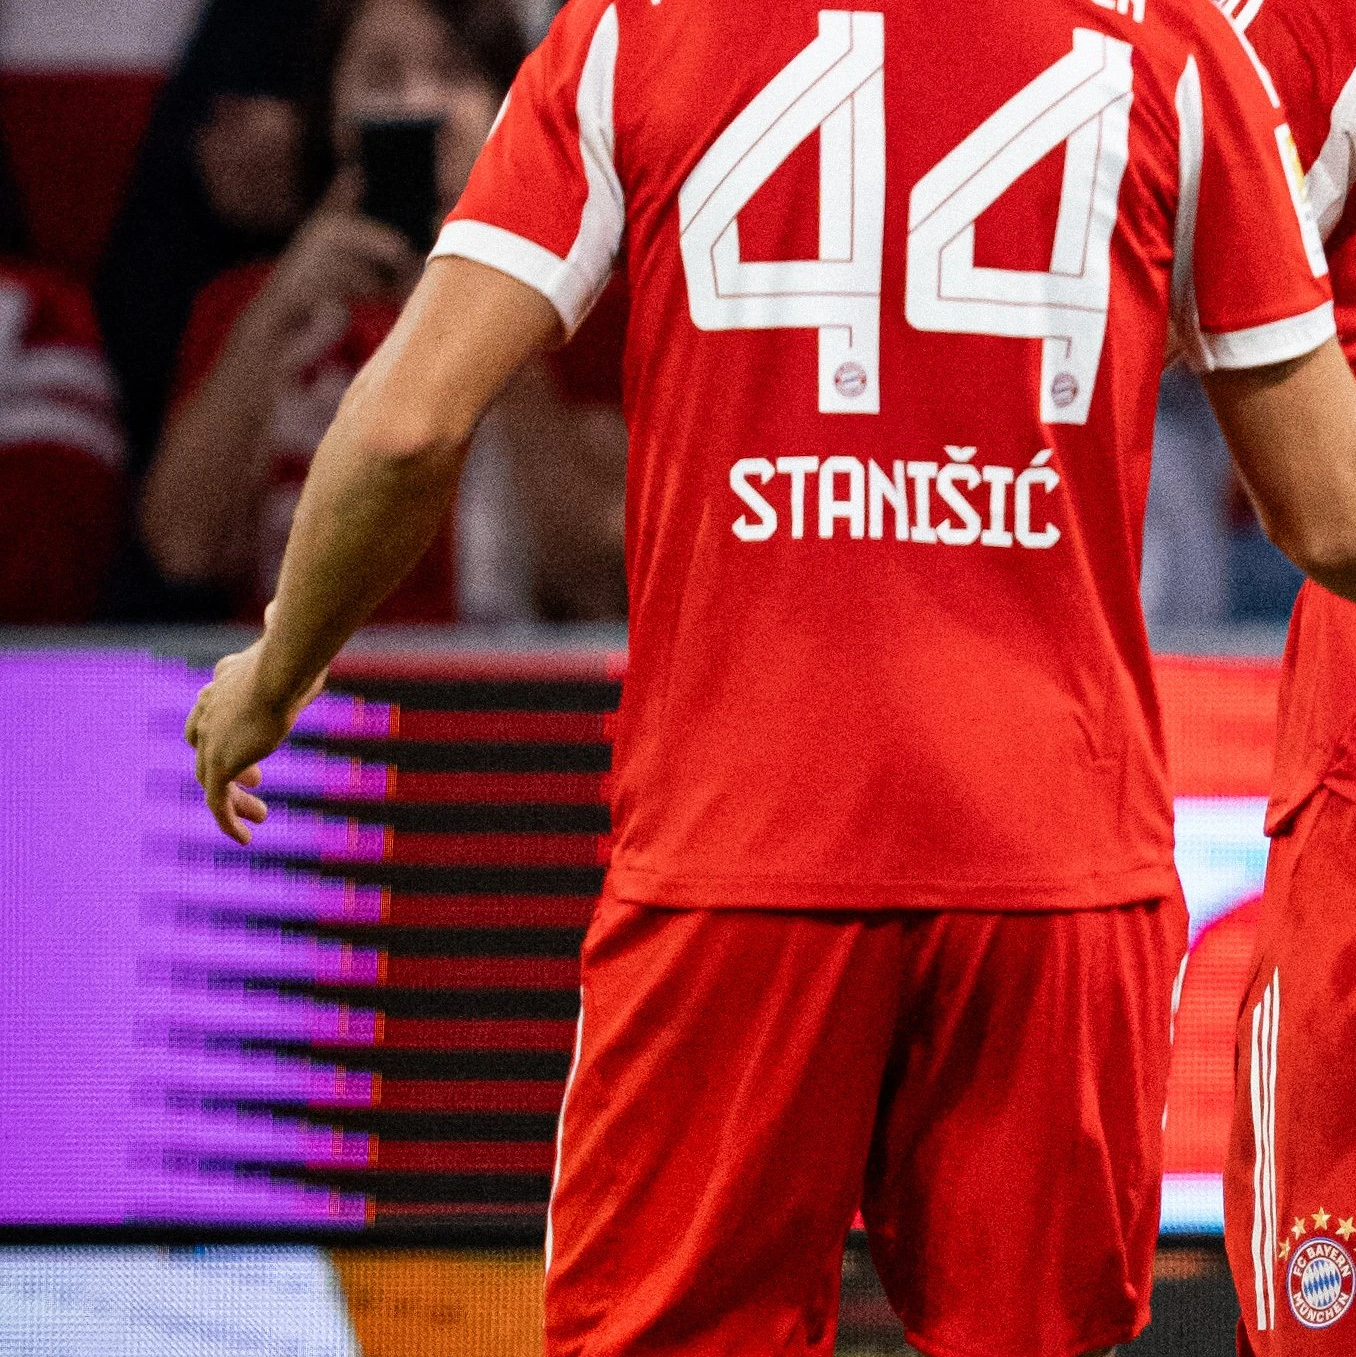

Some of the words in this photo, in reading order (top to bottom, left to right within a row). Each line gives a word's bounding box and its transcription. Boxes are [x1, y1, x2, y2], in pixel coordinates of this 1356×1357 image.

[679, 9, 1133, 424] 44
[729, 445, 1060, 549] STANIŠIĆ
[1293, 1256, 1307, 1277] FC
[1306, 1244, 1351, 1277] BAYERN
